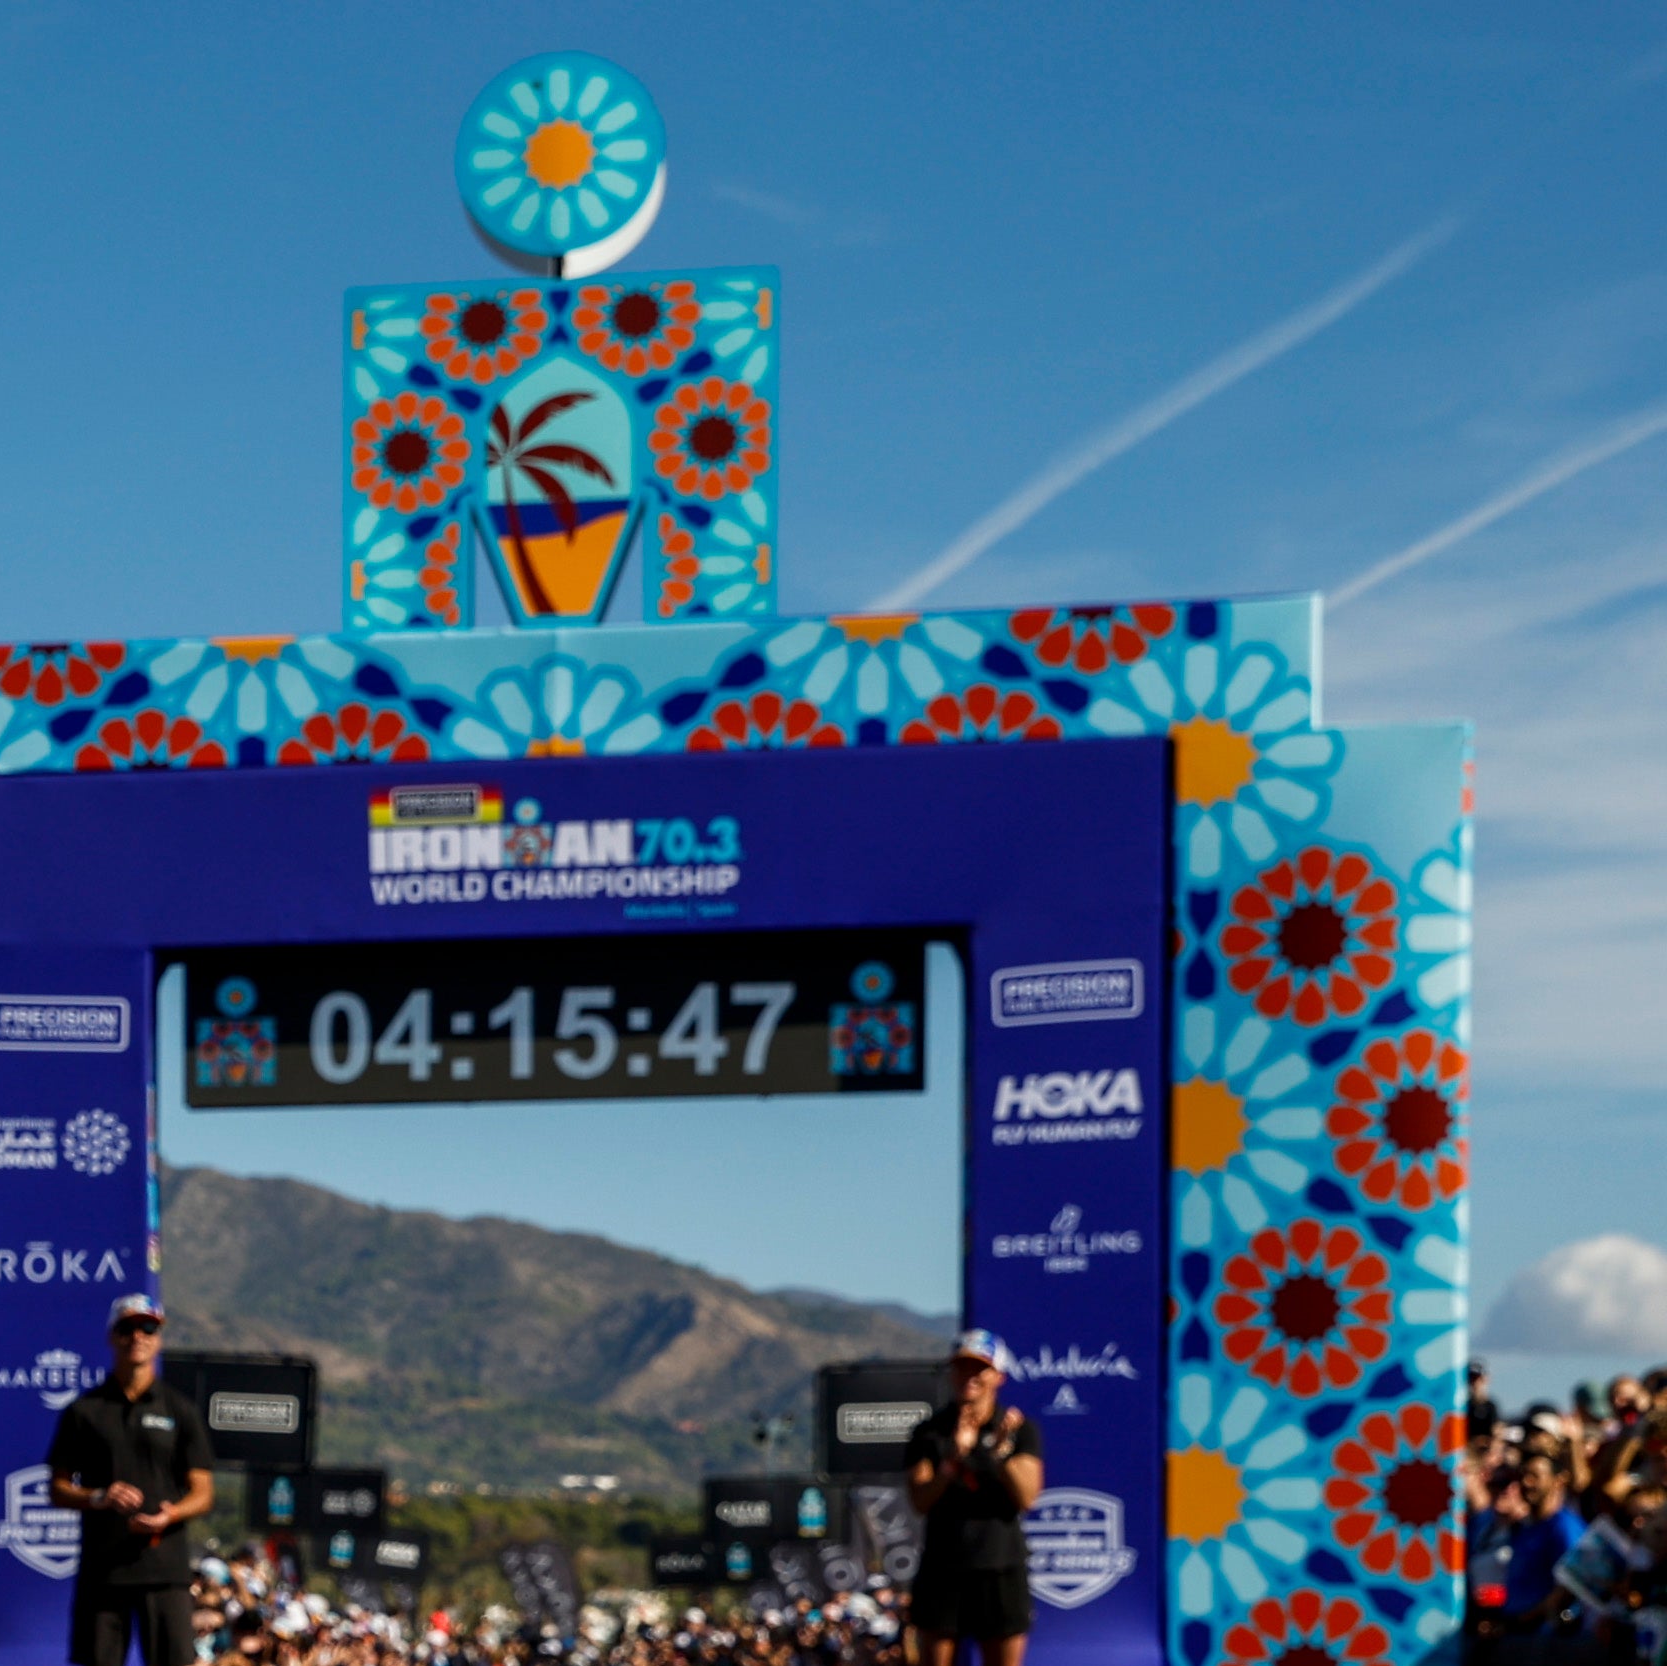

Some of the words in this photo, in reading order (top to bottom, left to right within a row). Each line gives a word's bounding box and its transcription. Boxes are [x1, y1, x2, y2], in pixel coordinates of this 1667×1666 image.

[636, 815, 740, 865] 70.3
[371, 872, 487, 905] WORLD
[492, 865, 740, 901] CHAMPIONSHIP
[0, 1006, 117, 1027] PRECISION
[308, 981, 796, 1084] 04:15:47
[992, 1067, 1145, 1121] HOKA
[992, 1230, 1143, 1258] BREITLING
